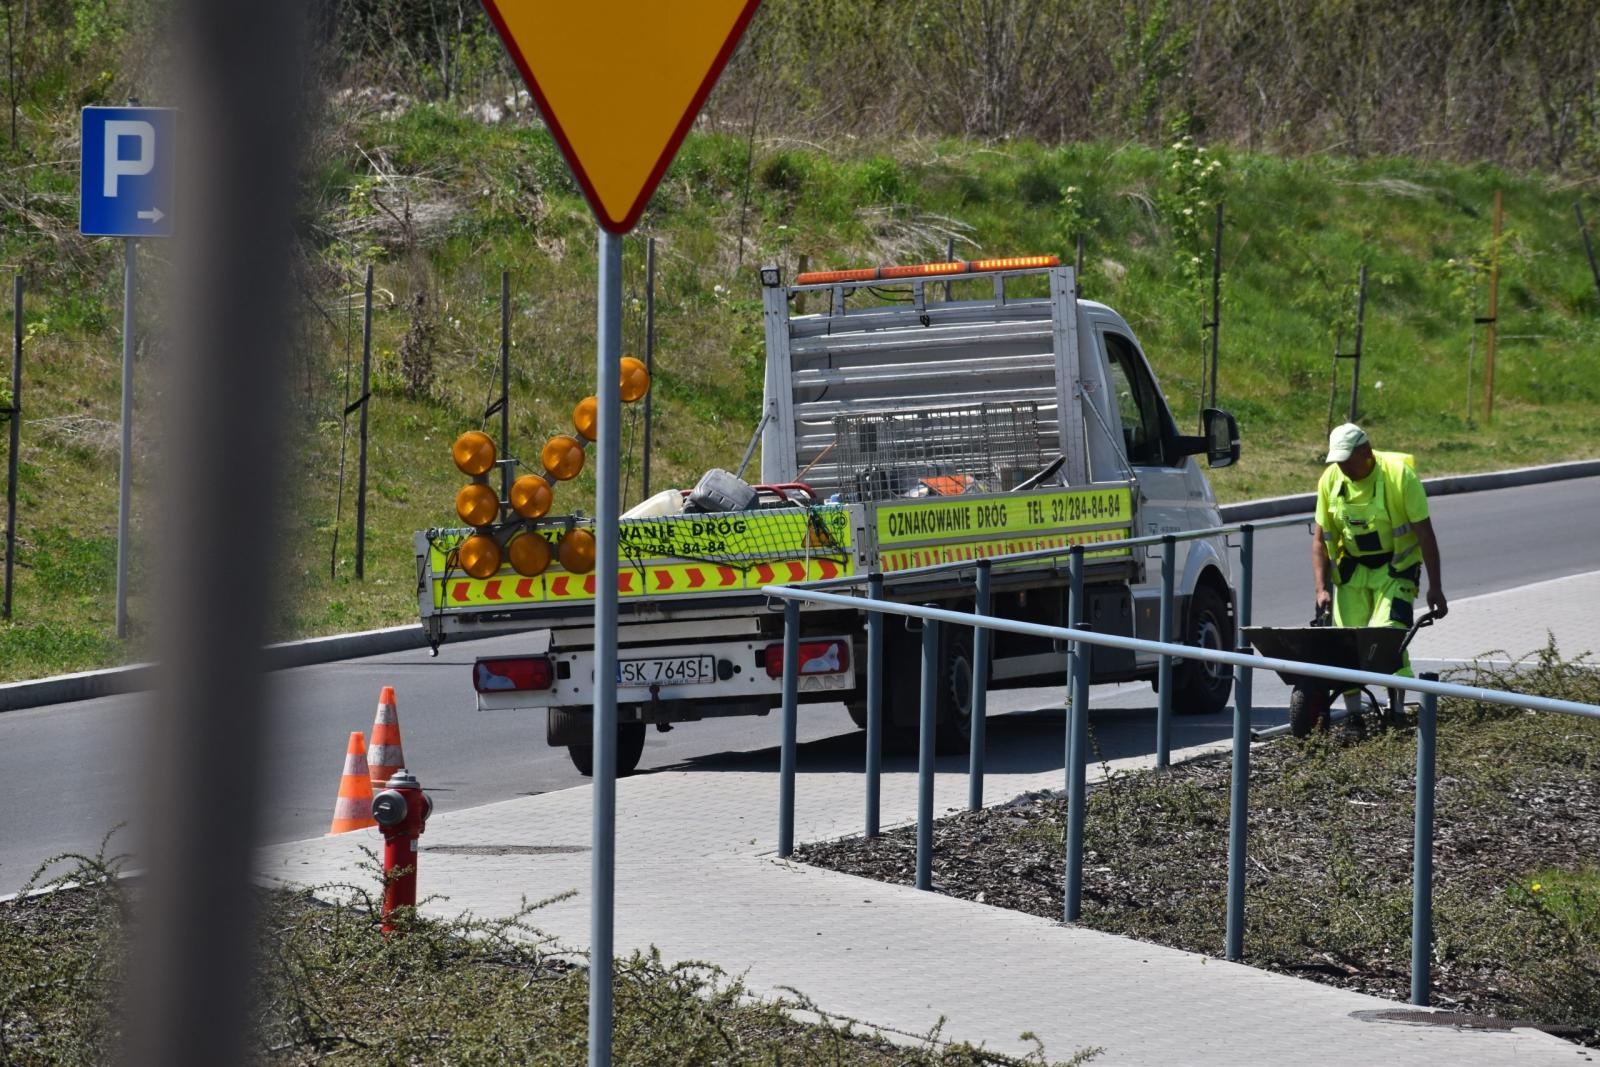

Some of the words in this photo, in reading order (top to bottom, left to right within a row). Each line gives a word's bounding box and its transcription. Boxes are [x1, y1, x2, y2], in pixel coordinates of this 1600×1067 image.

[103, 119, 156, 198] P
[888, 506, 971, 537] OZNAKOWANIE
[977, 500, 1008, 528] DRÓG
[1027, 500, 1045, 524] TEL
[1051, 493, 1121, 523] 32/284-84-84
[624, 663, 647, 682] SK
[798, 674, 846, 692] AN
